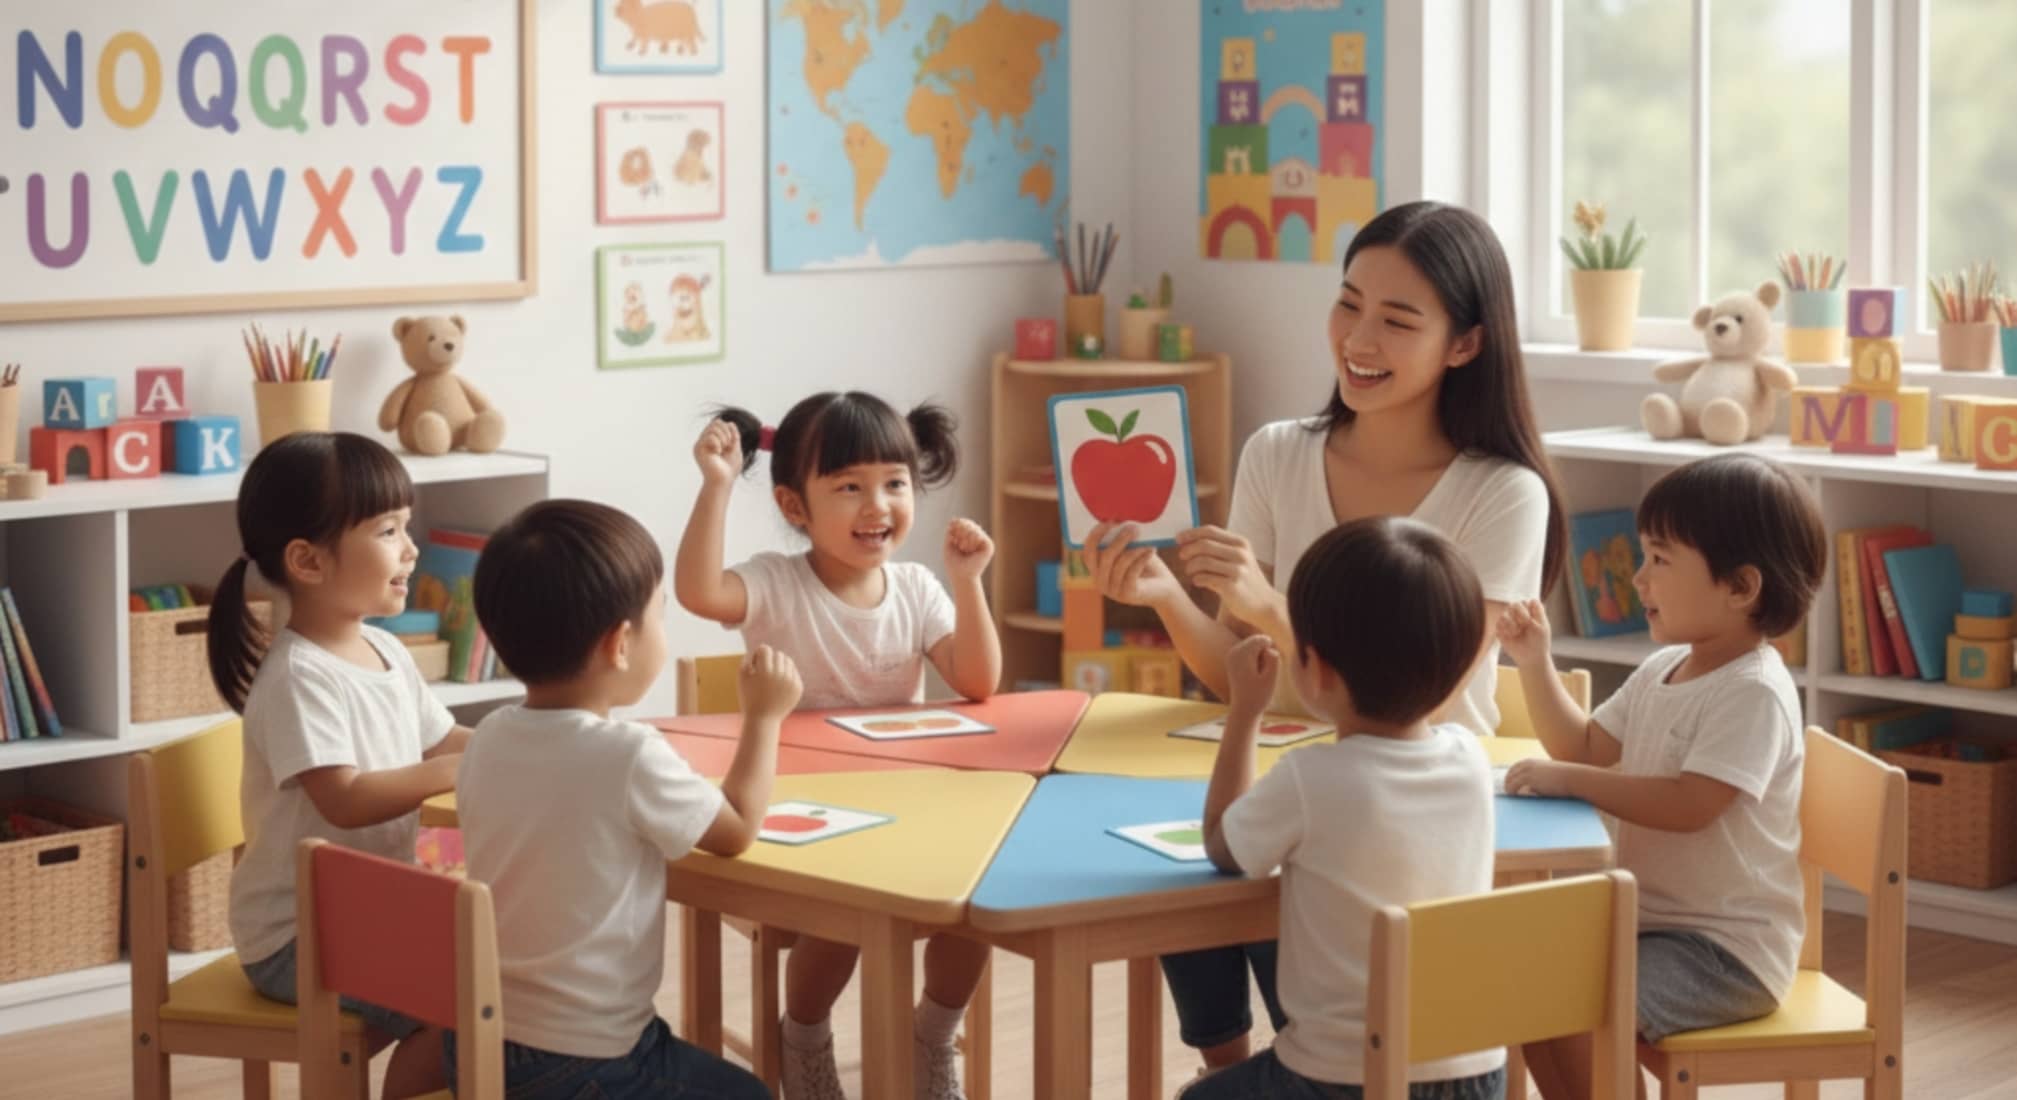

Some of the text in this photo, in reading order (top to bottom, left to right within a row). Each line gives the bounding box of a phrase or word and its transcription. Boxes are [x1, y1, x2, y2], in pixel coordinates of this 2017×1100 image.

[48, 387, 80, 421] A
[140, 375, 182, 413] A
[1801, 394, 1856, 442] M
[1982, 415, 2017, 463] C
[113, 431, 149, 474] C
[201, 426, 236, 470] K
